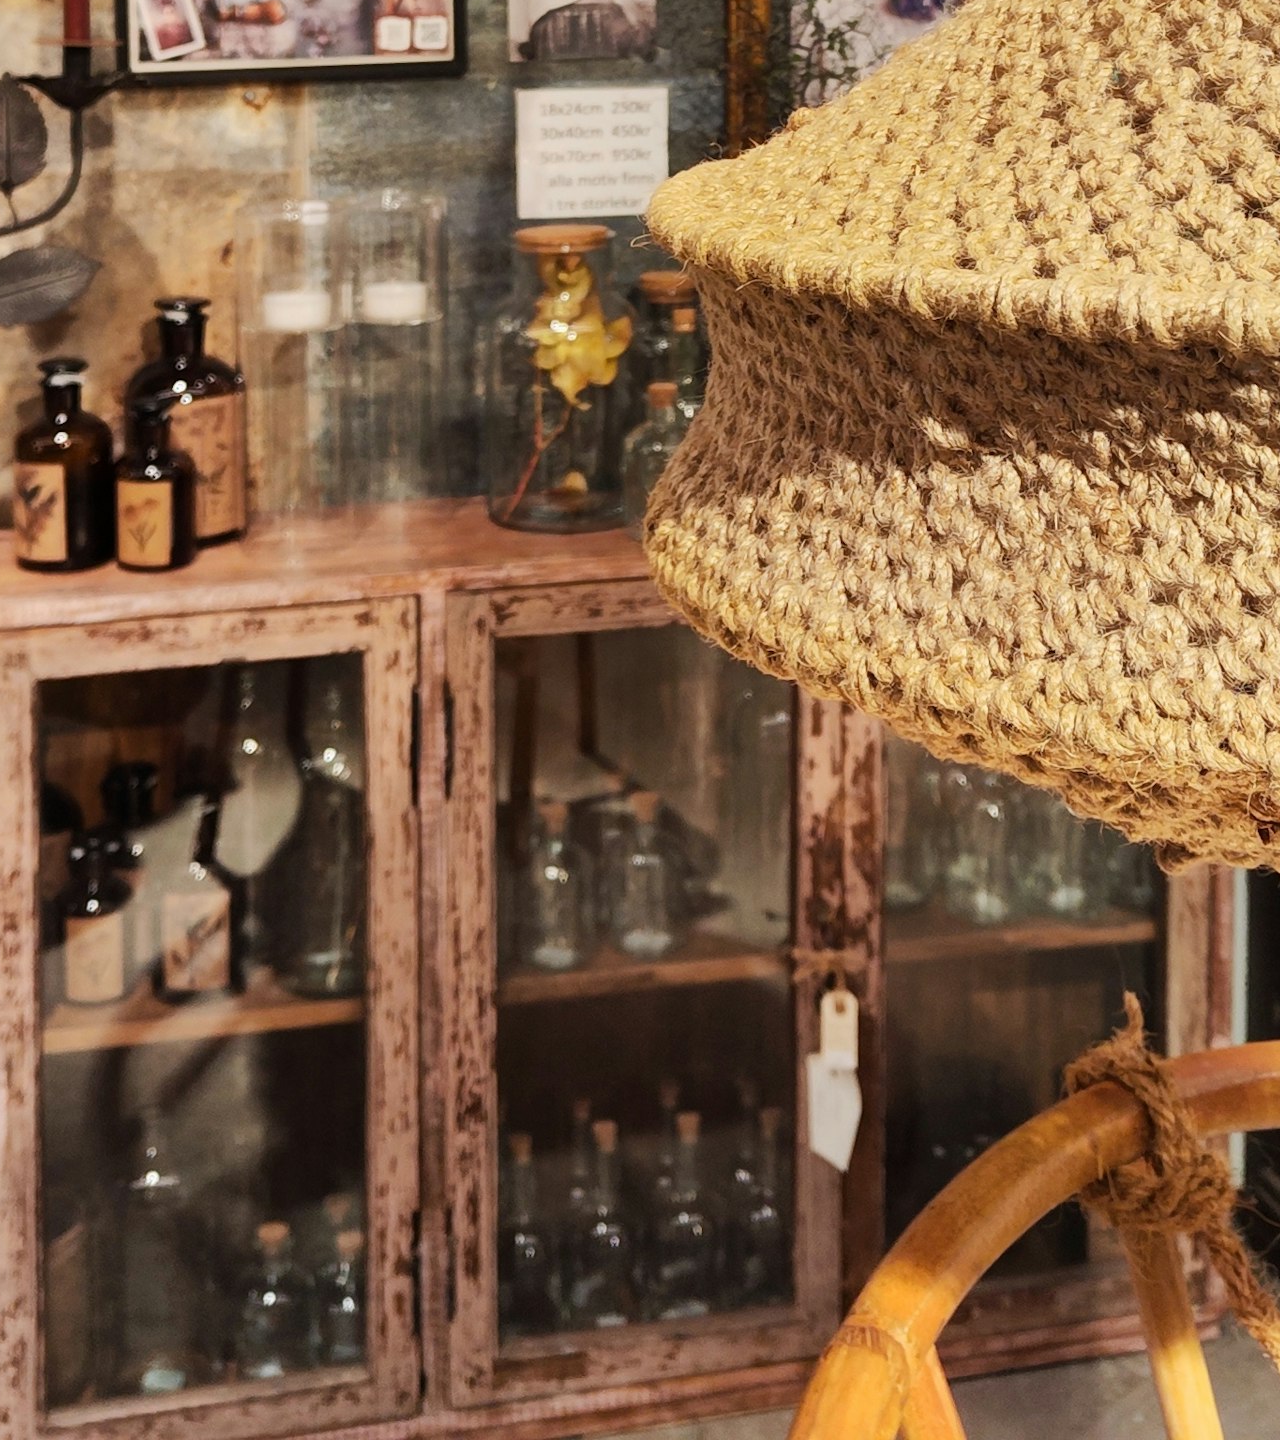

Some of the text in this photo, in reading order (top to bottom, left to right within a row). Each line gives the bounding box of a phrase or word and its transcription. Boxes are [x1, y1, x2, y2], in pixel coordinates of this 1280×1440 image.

[539, 101, 652, 117] 18x24cm 250kr
[539, 124, 652, 140] 30x40cm 450kr
[539, 150, 604, 164] 50x70cm
[548, 171, 656, 187] alla motiv finns
[556, 199, 577, 211] tre
[580, 196, 643, 210] storlekar
